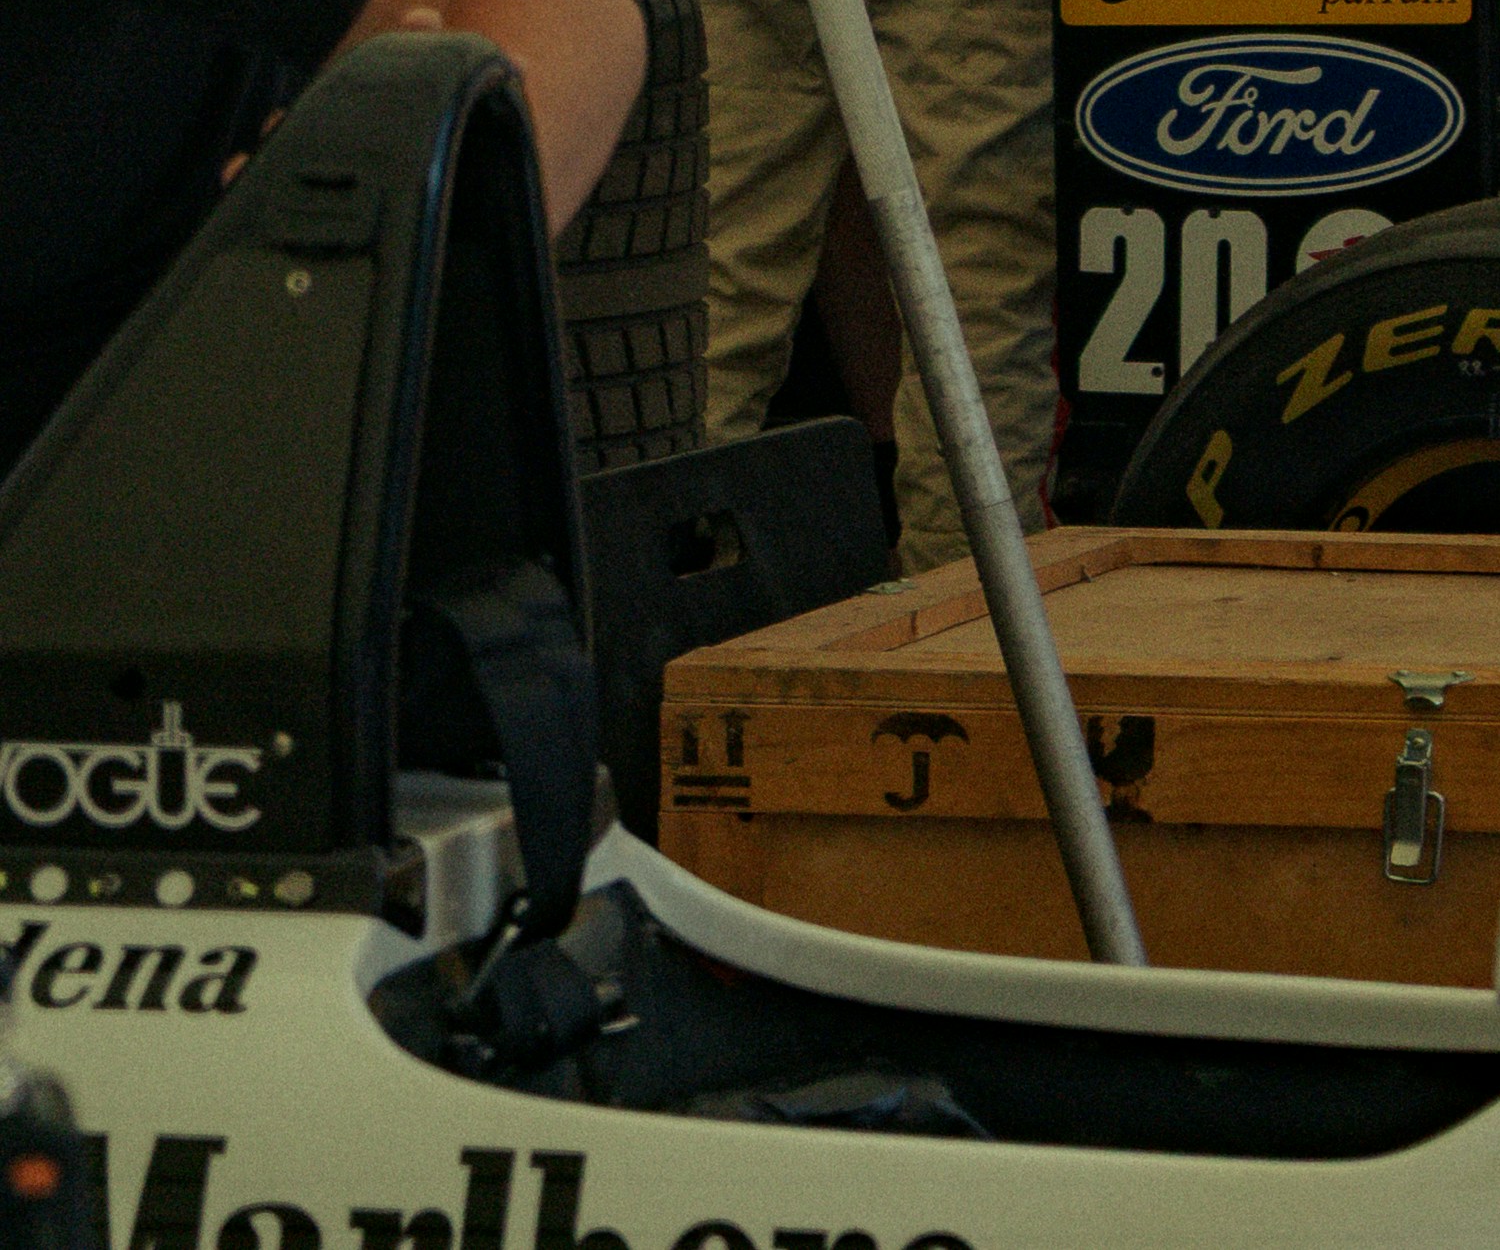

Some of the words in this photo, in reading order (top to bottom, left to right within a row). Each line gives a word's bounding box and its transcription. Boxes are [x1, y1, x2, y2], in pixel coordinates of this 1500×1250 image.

[1155, 62, 1384, 157] Ford
[1184, 427, 1234, 530] P
[0, 736, 262, 832] OGUE
